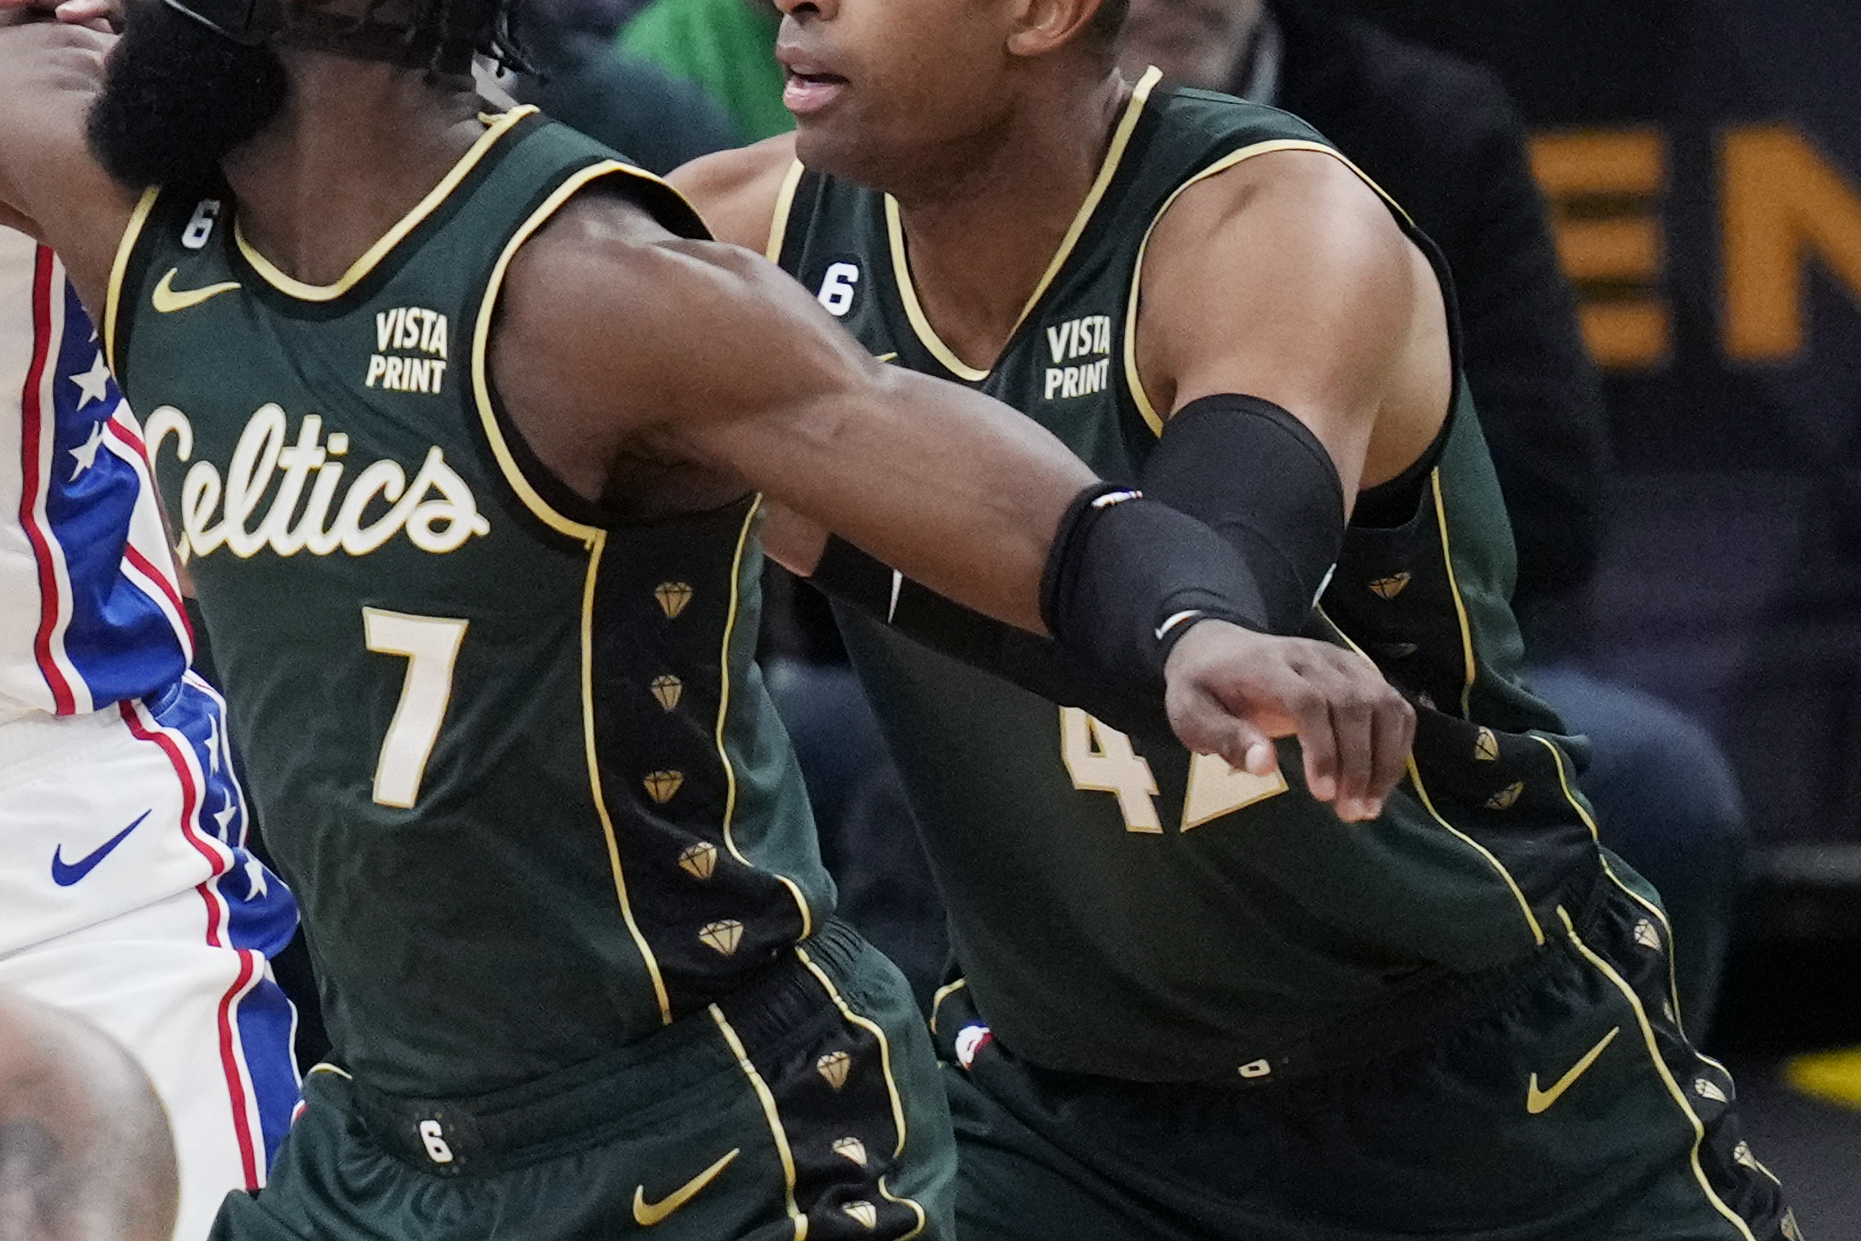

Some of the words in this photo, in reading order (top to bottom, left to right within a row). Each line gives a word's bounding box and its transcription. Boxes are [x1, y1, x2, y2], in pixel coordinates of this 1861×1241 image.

[181, 199, 221, 249] 6
[817, 261, 860, 316] 6
[376, 306, 448, 360] VISTA
[1045, 315, 1111, 364] VISTA
[365, 354, 447, 394] PRINT
[1044, 357, 1110, 400] PRINT
[143, 402, 491, 567] Celtics
[362, 606, 469, 809] 7
[419, 1119, 454, 1164] 6
